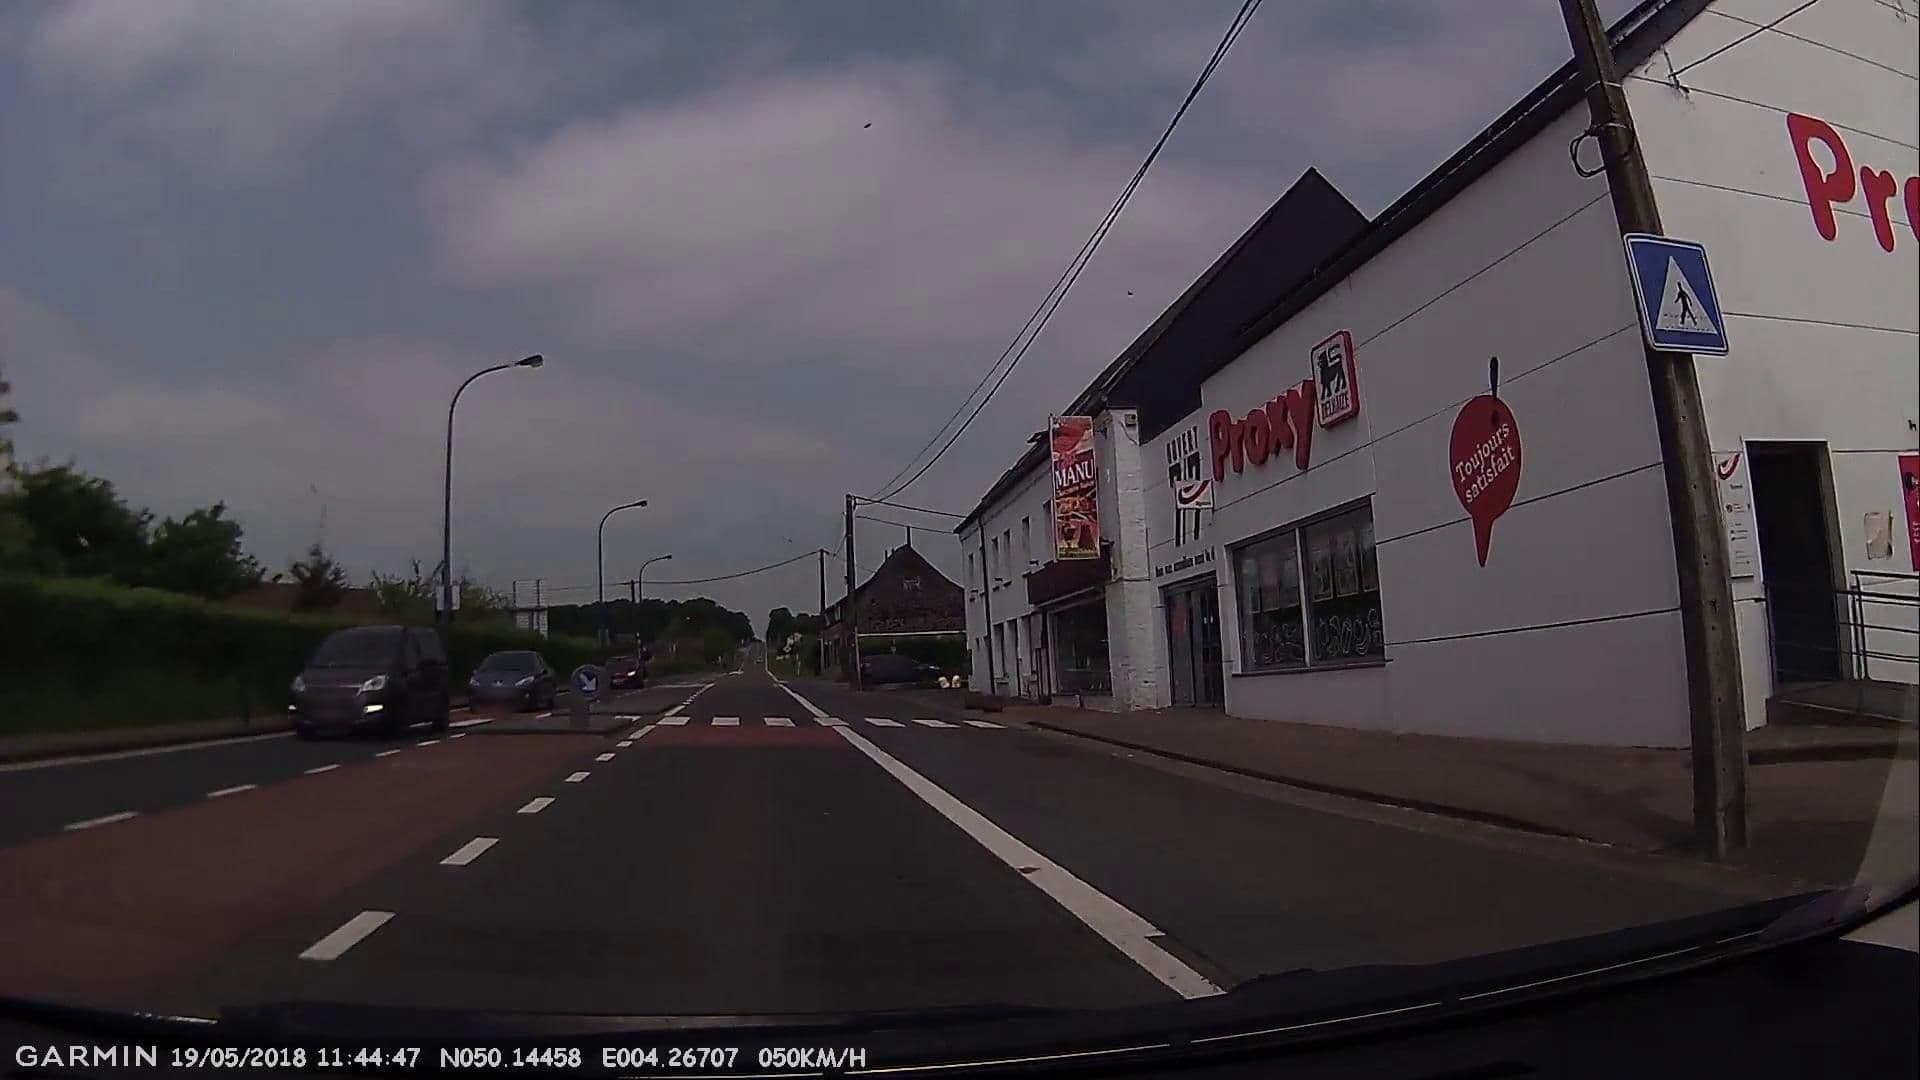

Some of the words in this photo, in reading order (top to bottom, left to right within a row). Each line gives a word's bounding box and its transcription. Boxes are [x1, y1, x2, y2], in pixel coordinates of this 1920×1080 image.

[1208, 378, 1315, 482] Proxy
[1455, 422, 1511, 483] Toujours
[1055, 459, 1094, 490] MANU
[1465, 446, 1516, 504] satisfait
